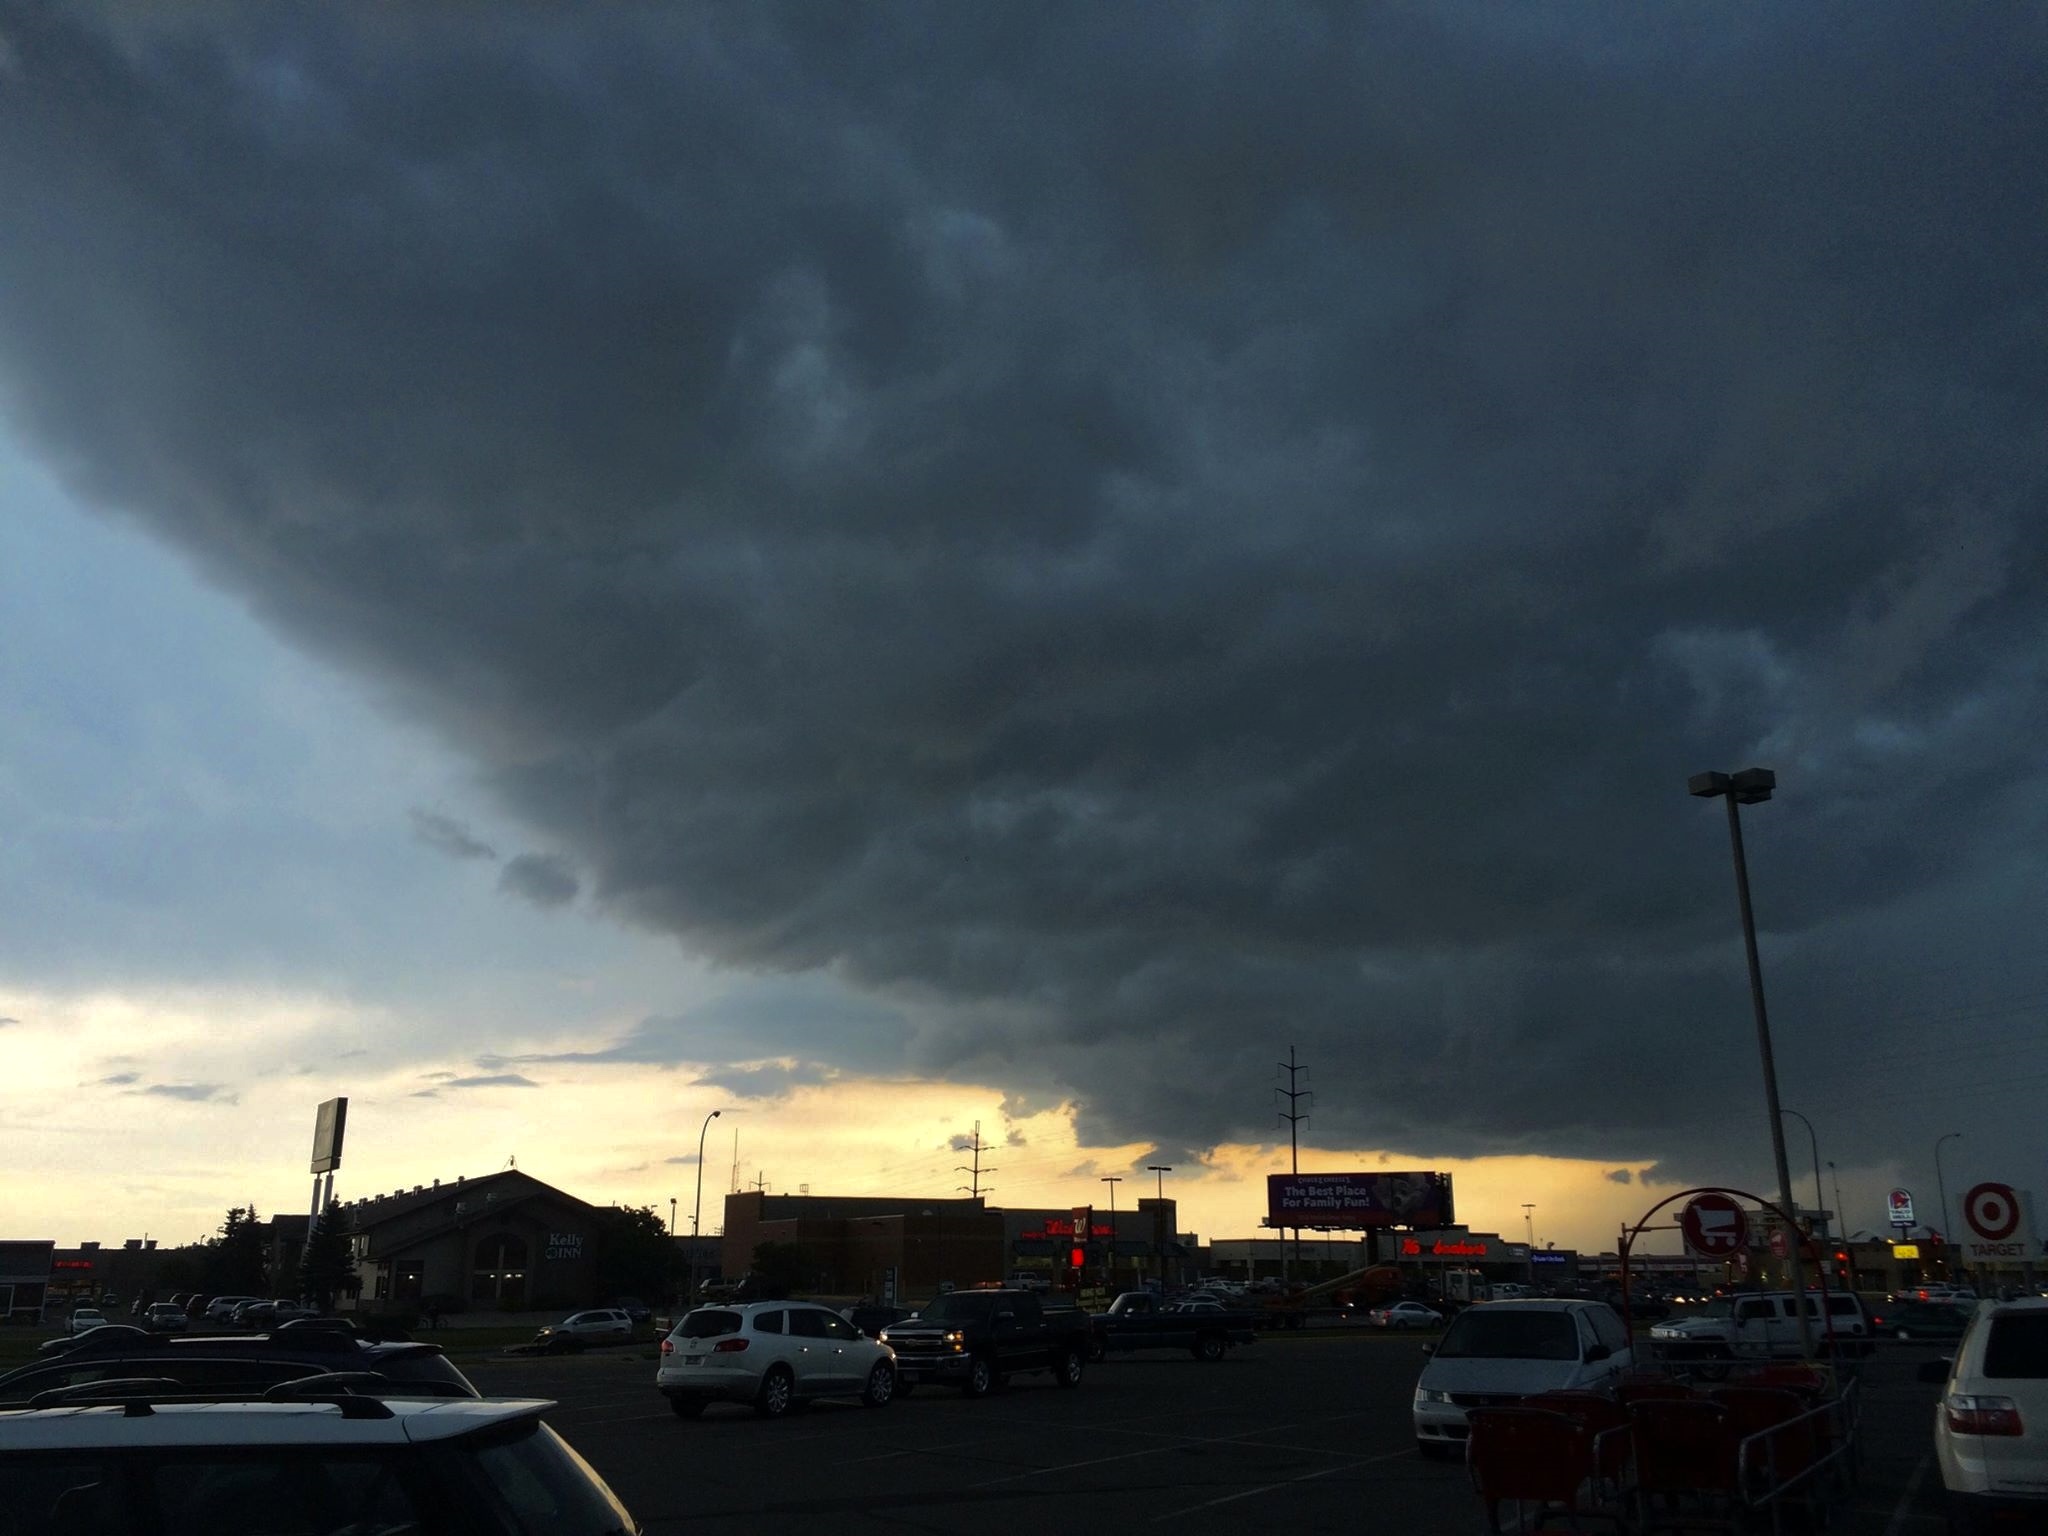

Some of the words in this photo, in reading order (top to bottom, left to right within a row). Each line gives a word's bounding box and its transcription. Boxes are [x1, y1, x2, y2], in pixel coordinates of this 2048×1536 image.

[1285, 1186, 1306, 1197] The
[1308, 1186, 1334, 1196] Best
[1336, 1185, 1367, 1196] Place
[1282, 1198, 1301, 1208] For
[1303, 1197, 1341, 1209] Family
[1344, 1197, 1370, 1207] Fun!
[549, 1232, 583, 1248] Kelly
[558, 1247, 582, 1259] INN
[1970, 1243, 2025, 1257] TARGET
